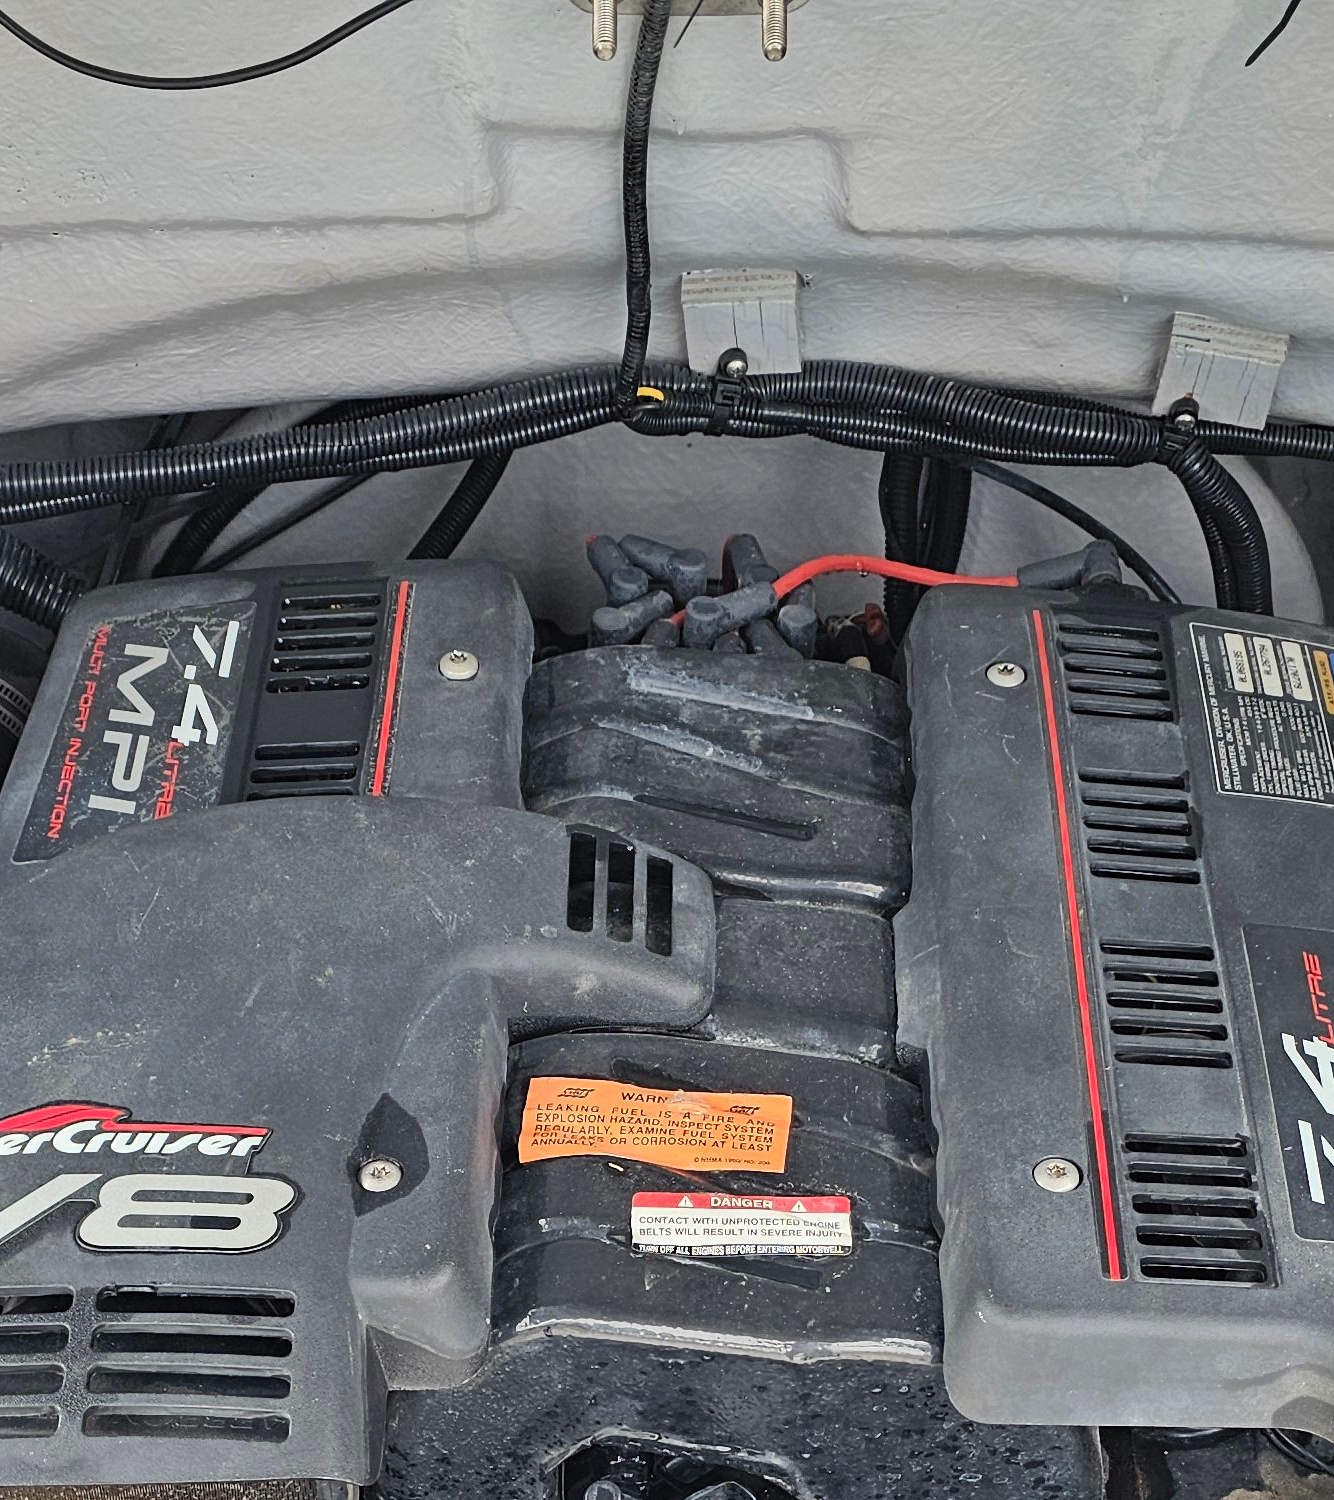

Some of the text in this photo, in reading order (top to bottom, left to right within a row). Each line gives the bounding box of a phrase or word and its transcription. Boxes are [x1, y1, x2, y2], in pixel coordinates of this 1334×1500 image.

[171, 620, 240, 746] 7.4
[47, 625, 110, 839] MULTI PORT INJECTION
[88, 643, 169, 815] MPI
[537, 1104, 599, 1113] LEAKING
[612, 1106, 646, 1117] FUEL
[659, 1109, 672, 1119] IS
[683, 1111, 691, 1120] A
[703, 1114, 734, 1123] FIRE
[536, 1113, 605, 1123] EXPLOSION
[668, 1119, 718, 1131] INSPECT
[724, 1123, 774, 1135] SYSTEM
[620, 1125, 676, 1136] EXAMINE
[683, 1129, 715, 1139] FUEL
[722, 1132, 773, 1144] SYSTEM
[610, 1137, 626, 1145] OR
[633, 1137, 707, 1147] CORROSION
[711, 1141, 725, 1149] AT
[732, 1142, 772, 1152] LEAST
[711, 1196, 773, 1209] DANGER
[639, 1228, 671, 1236] BELTS
[703, 1228, 743, 1236] RESULT
[761, 1229, 801, 1237] SEVERE
[806, 1229, 843, 1237] INJURY
[693, 1217, 718, 1225] WITH
[722, 1217, 800, 1226] UNPROTECTED
[804, 1220, 840, 1229] ENGINE
[660, 1246, 674, 1254] OFF
[726, 1246, 755, 1254] BEFORE
